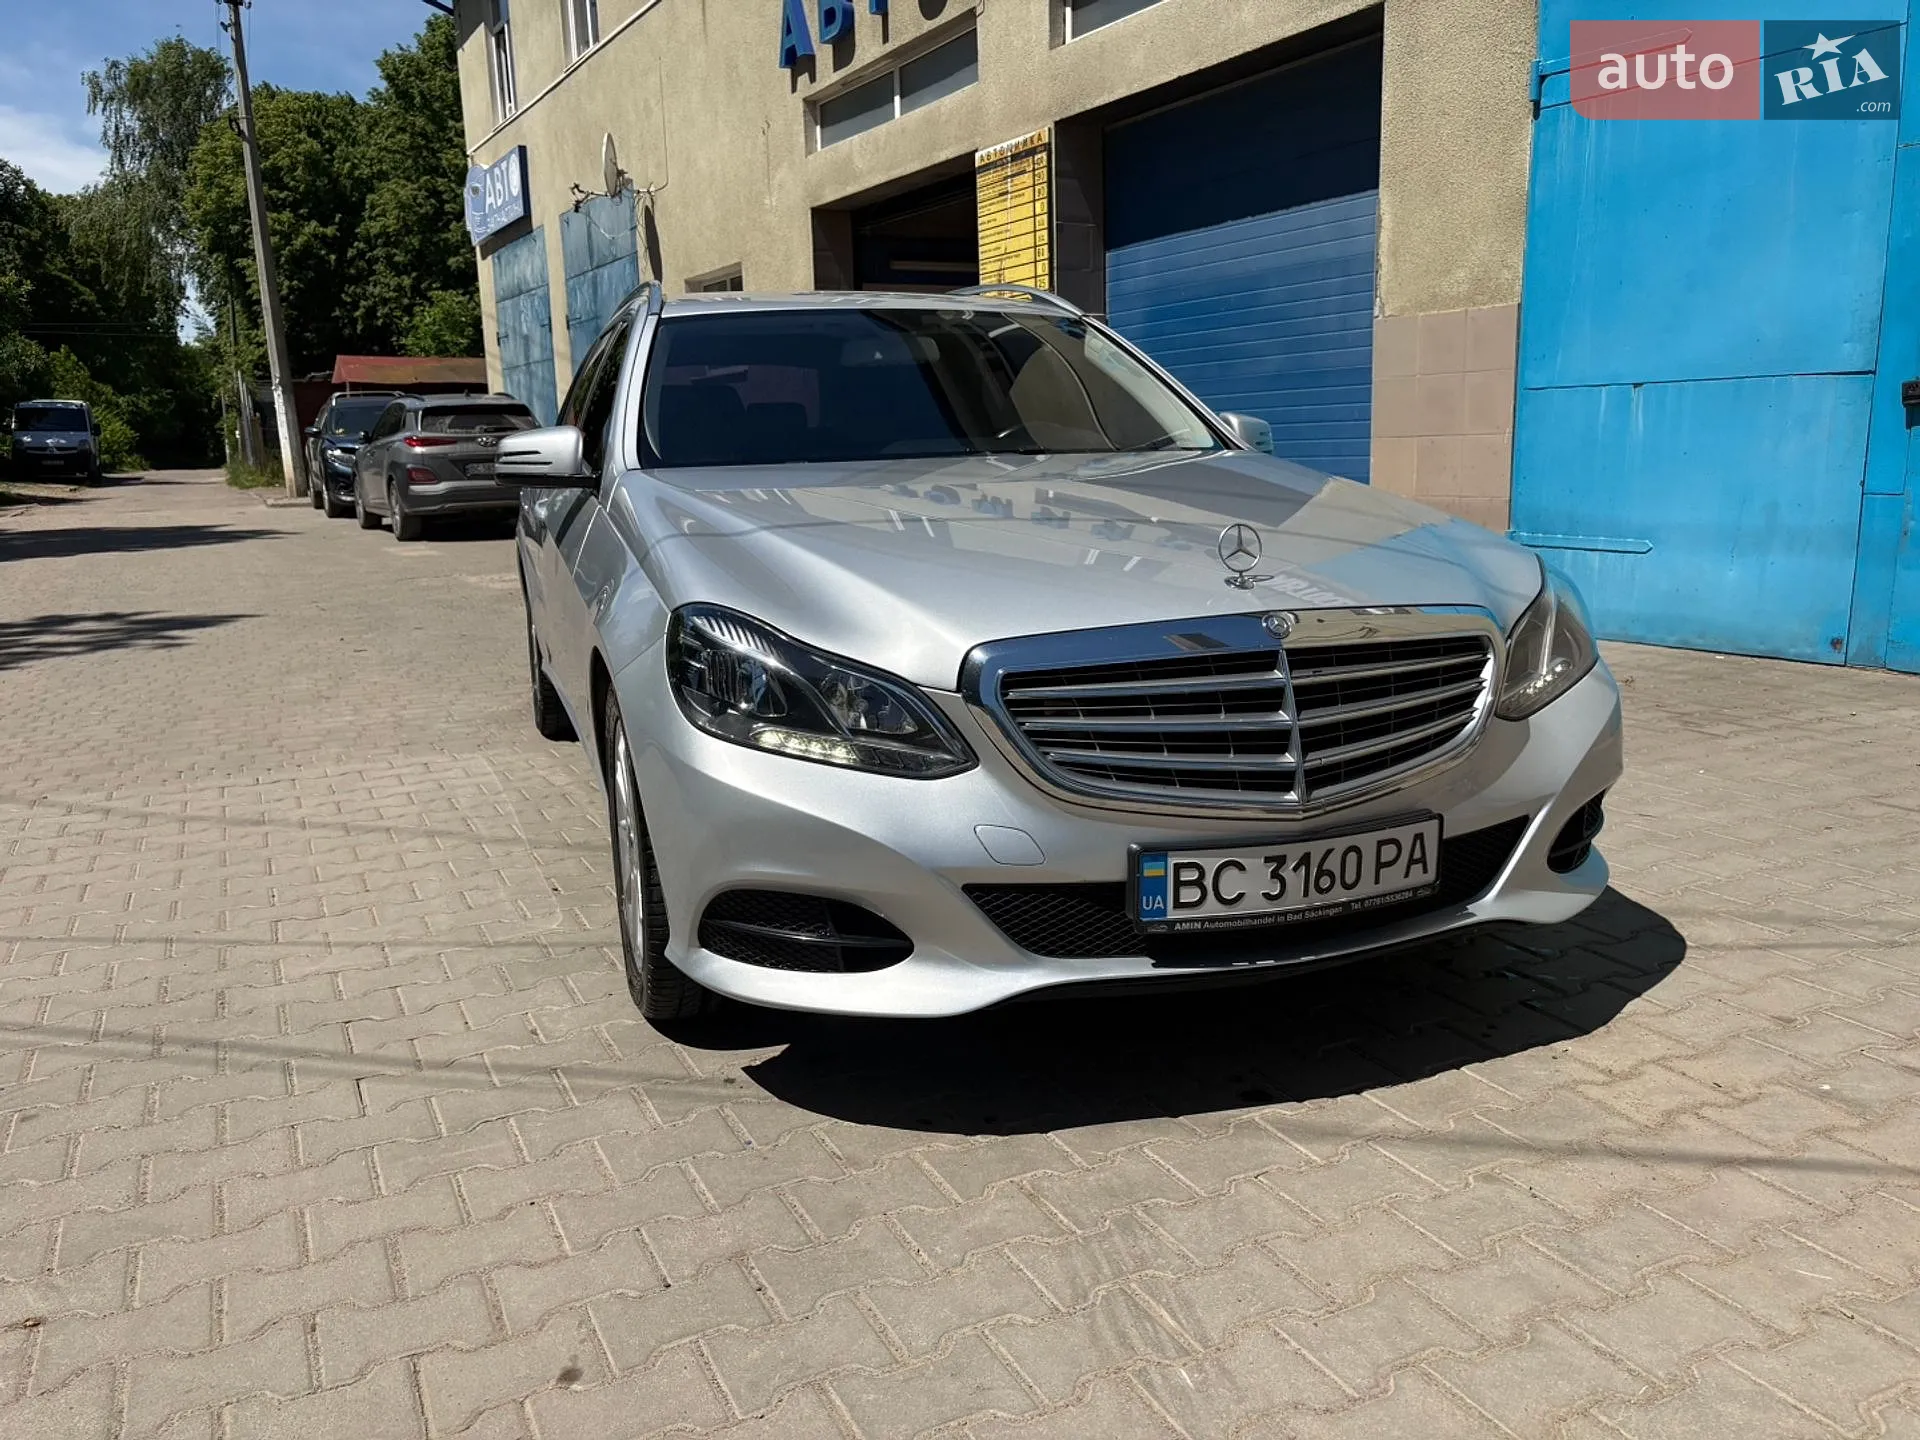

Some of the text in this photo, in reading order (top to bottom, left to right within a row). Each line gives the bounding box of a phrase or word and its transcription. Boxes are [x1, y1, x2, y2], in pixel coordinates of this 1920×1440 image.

[1172, 831, 1430, 910] BC 3160 PA
[1142, 895, 1164, 911] UA
[1174, 921, 1202, 931] AMIN
[1203, 916, 1275, 929] Automobilhandel
[1277, 914, 1286, 923] in
[1286, 912, 1303, 922] Bad
